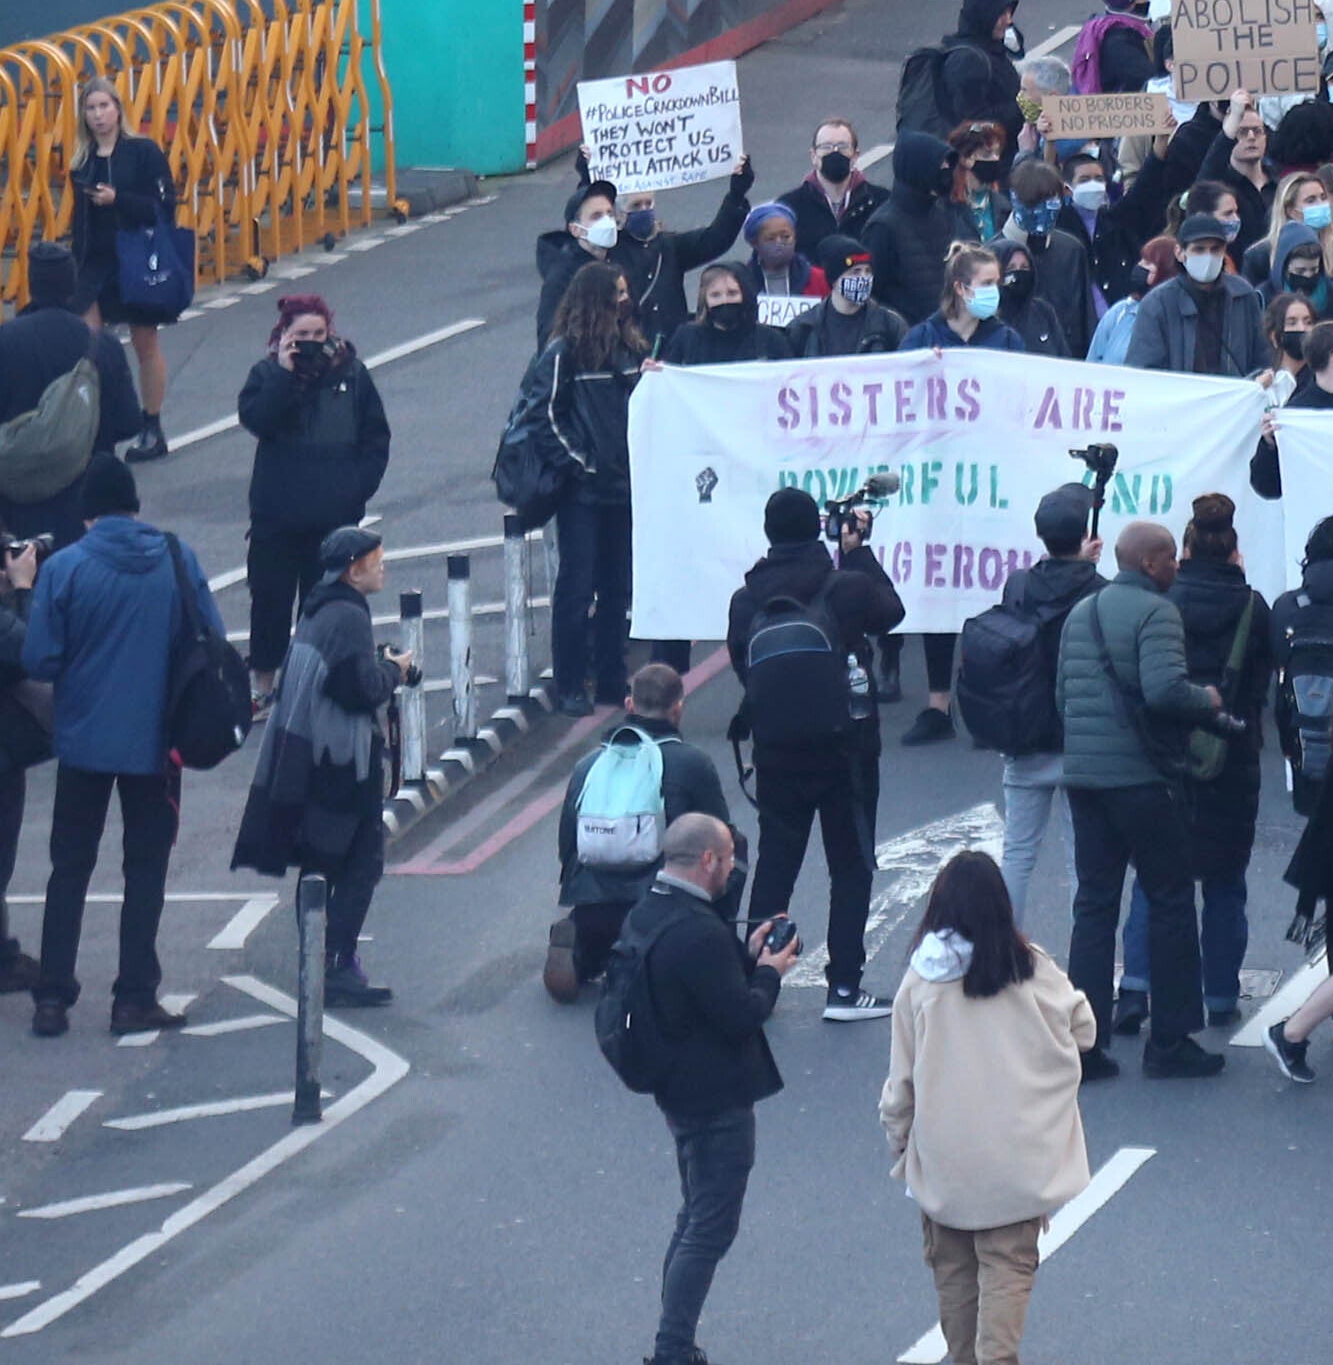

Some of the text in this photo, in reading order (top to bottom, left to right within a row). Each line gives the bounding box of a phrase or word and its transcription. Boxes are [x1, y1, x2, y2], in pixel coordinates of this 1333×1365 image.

[1209, 24, 1274, 51] THE
[626, 74, 672, 99] NO
[1178, 56, 1318, 100] POLICE
[1058, 96, 1155, 114] NO BORDERS
[590, 122, 629, 145] THEY
[1060, 114, 1156, 132] NO PRISONS
[599, 128, 715, 163] PROTECT US
[588, 143, 733, 183] THEY'LL ATTACK US
[777, 377, 1126, 432] SISTERS ARE
